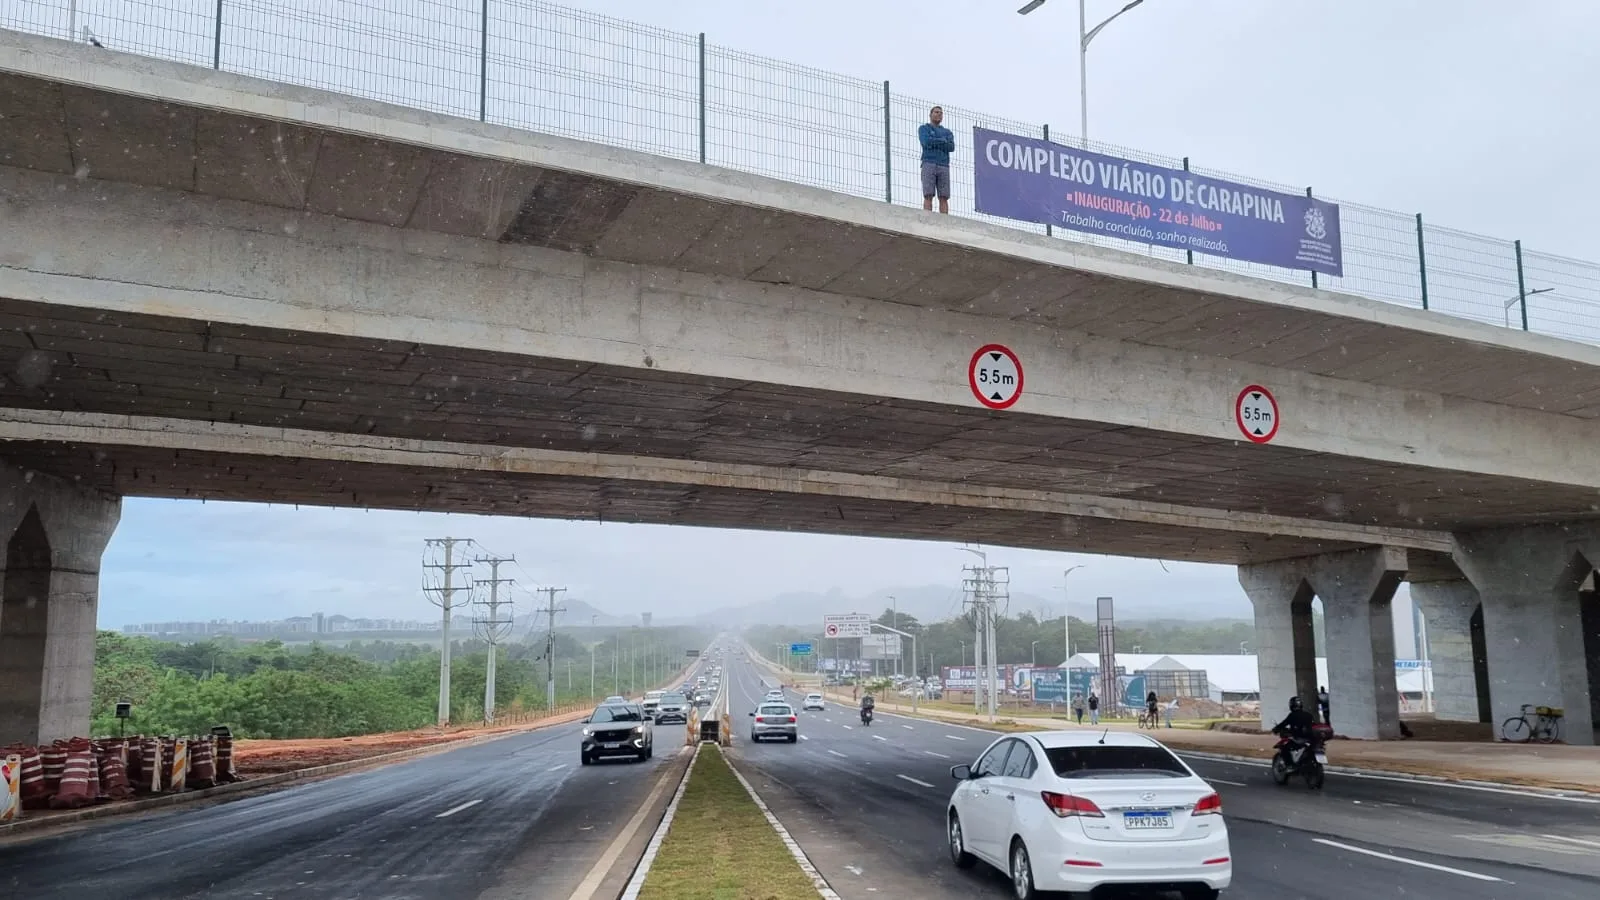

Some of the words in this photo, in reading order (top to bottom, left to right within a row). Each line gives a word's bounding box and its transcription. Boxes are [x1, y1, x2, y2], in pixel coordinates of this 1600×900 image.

[986, 139, 1095, 185] COMPLEXO
[1099, 162, 1166, 199] VIÁRIO
[1170, 177, 1195, 205] DE
[1197, 184, 1285, 223] CARAPINA
[1061, 210, 1104, 229] Trabalho
[1105, 222, 1154, 240] concluído,
[1156, 231, 1187, 244] sonho
[1188, 236, 1229, 253] realizado.
[1074, 191, 1151, 220] INAUGURAÇÃO
[1159, 208, 1172, 223] 22
[1174, 211, 1189, 225] de
[1190, 213, 1216, 231] Julho
